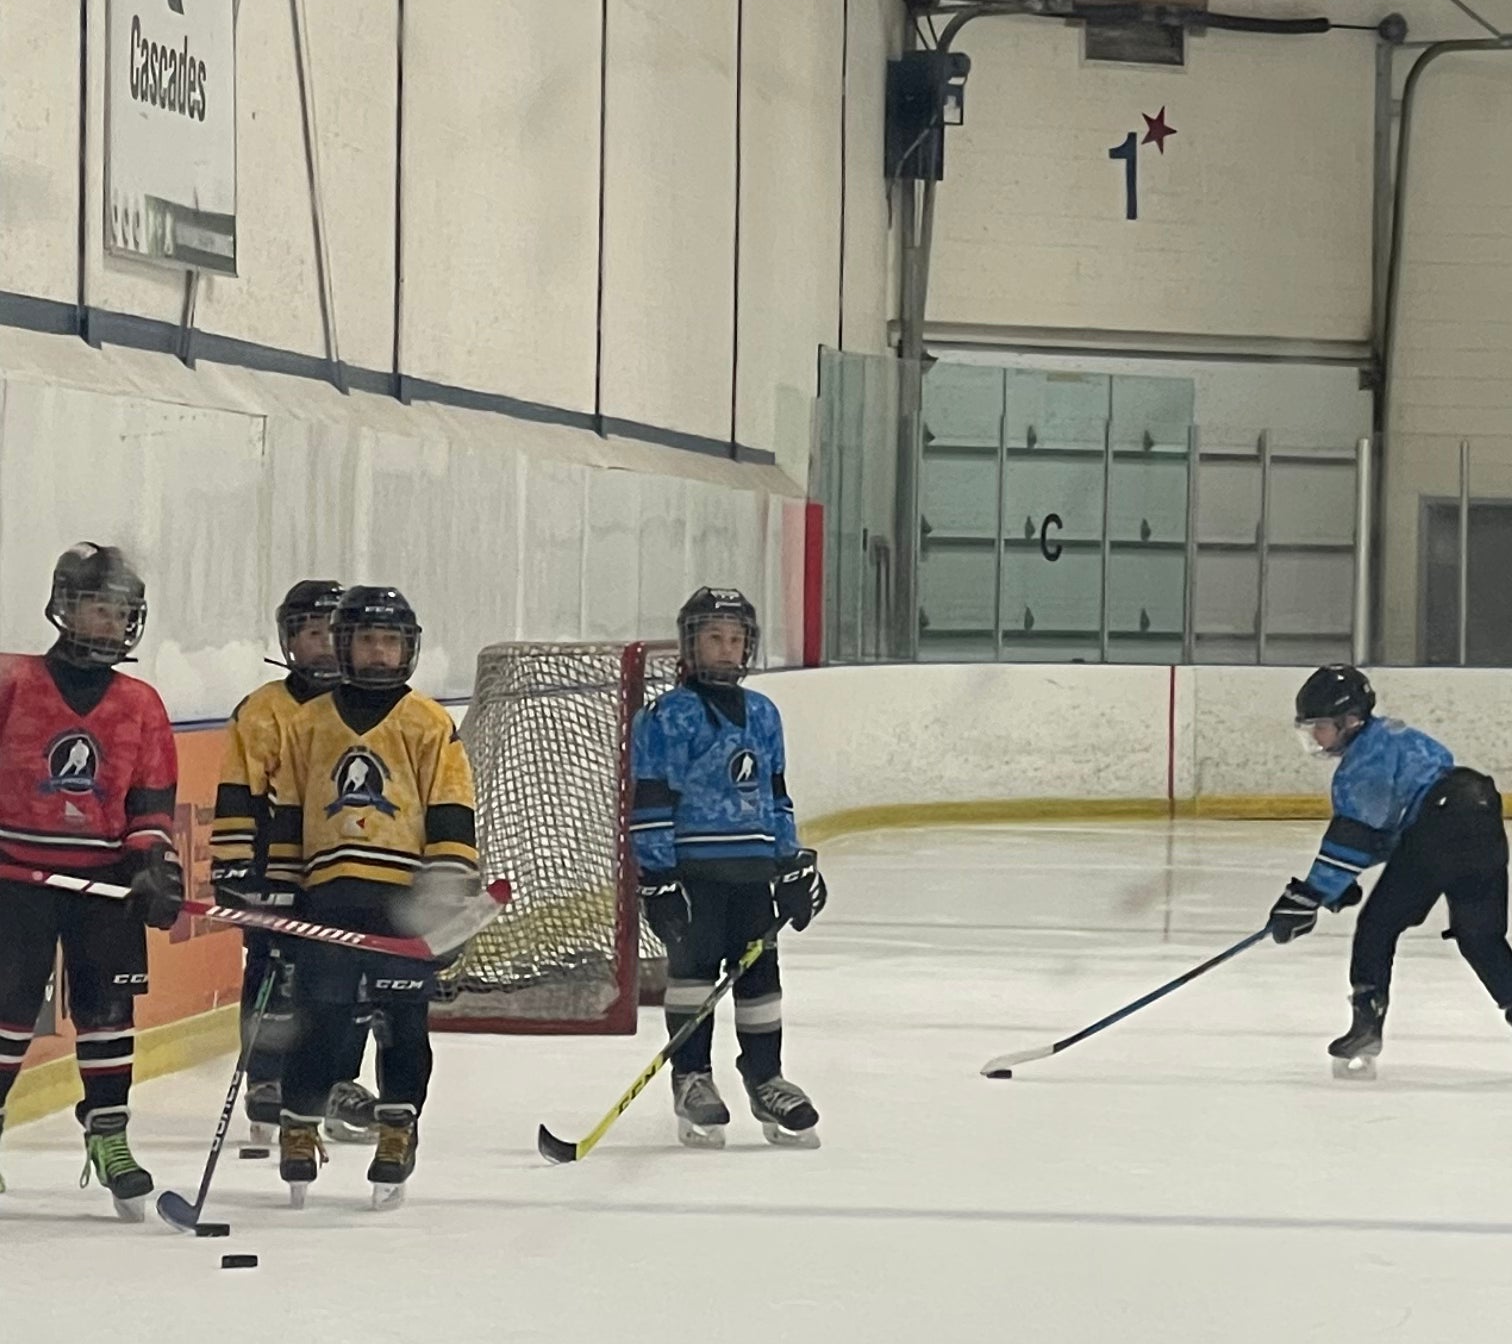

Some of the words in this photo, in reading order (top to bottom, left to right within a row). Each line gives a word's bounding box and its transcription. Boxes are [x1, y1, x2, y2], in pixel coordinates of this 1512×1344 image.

[130, 15, 206, 122] Cascades
[1108, 132, 1138, 220] 1
[1038, 513, 1064, 562] C
[211, 868, 248, 880] CM
[780, 864, 815, 884] CM
[112, 973, 149, 985] CC
[375, 979, 424, 990] CCM
